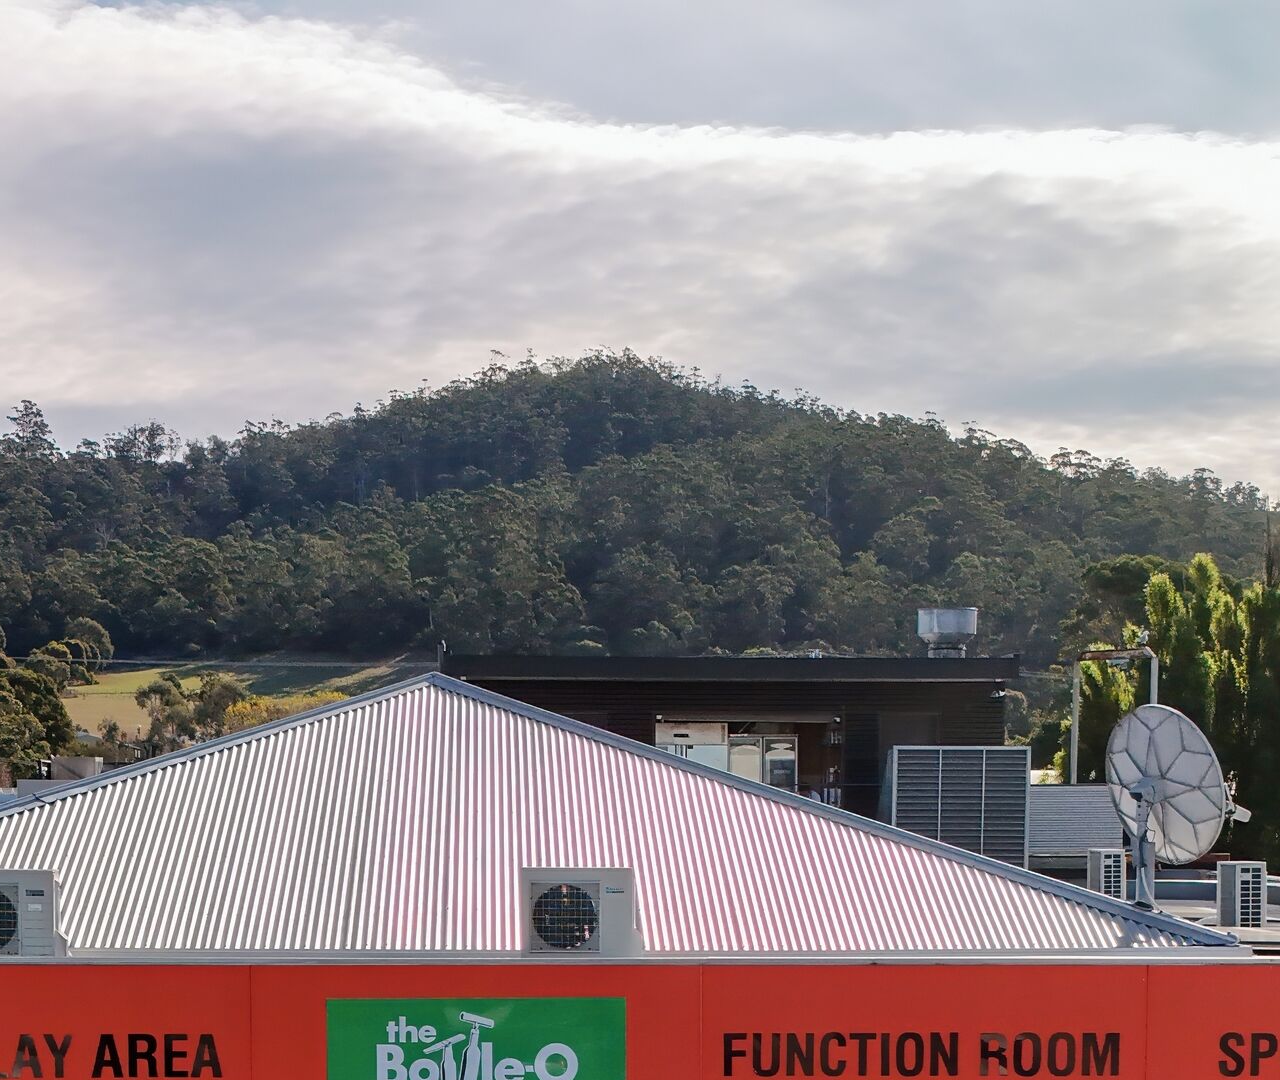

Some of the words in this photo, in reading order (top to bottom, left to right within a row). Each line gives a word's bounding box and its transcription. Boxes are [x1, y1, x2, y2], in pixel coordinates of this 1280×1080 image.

[386, 1016, 437, 1043] the
[91, 1033, 224, 1079] AREA
[722, 1031, 959, 1078] FUNCTION
[979, 1031, 1121, 1078] ROOM
